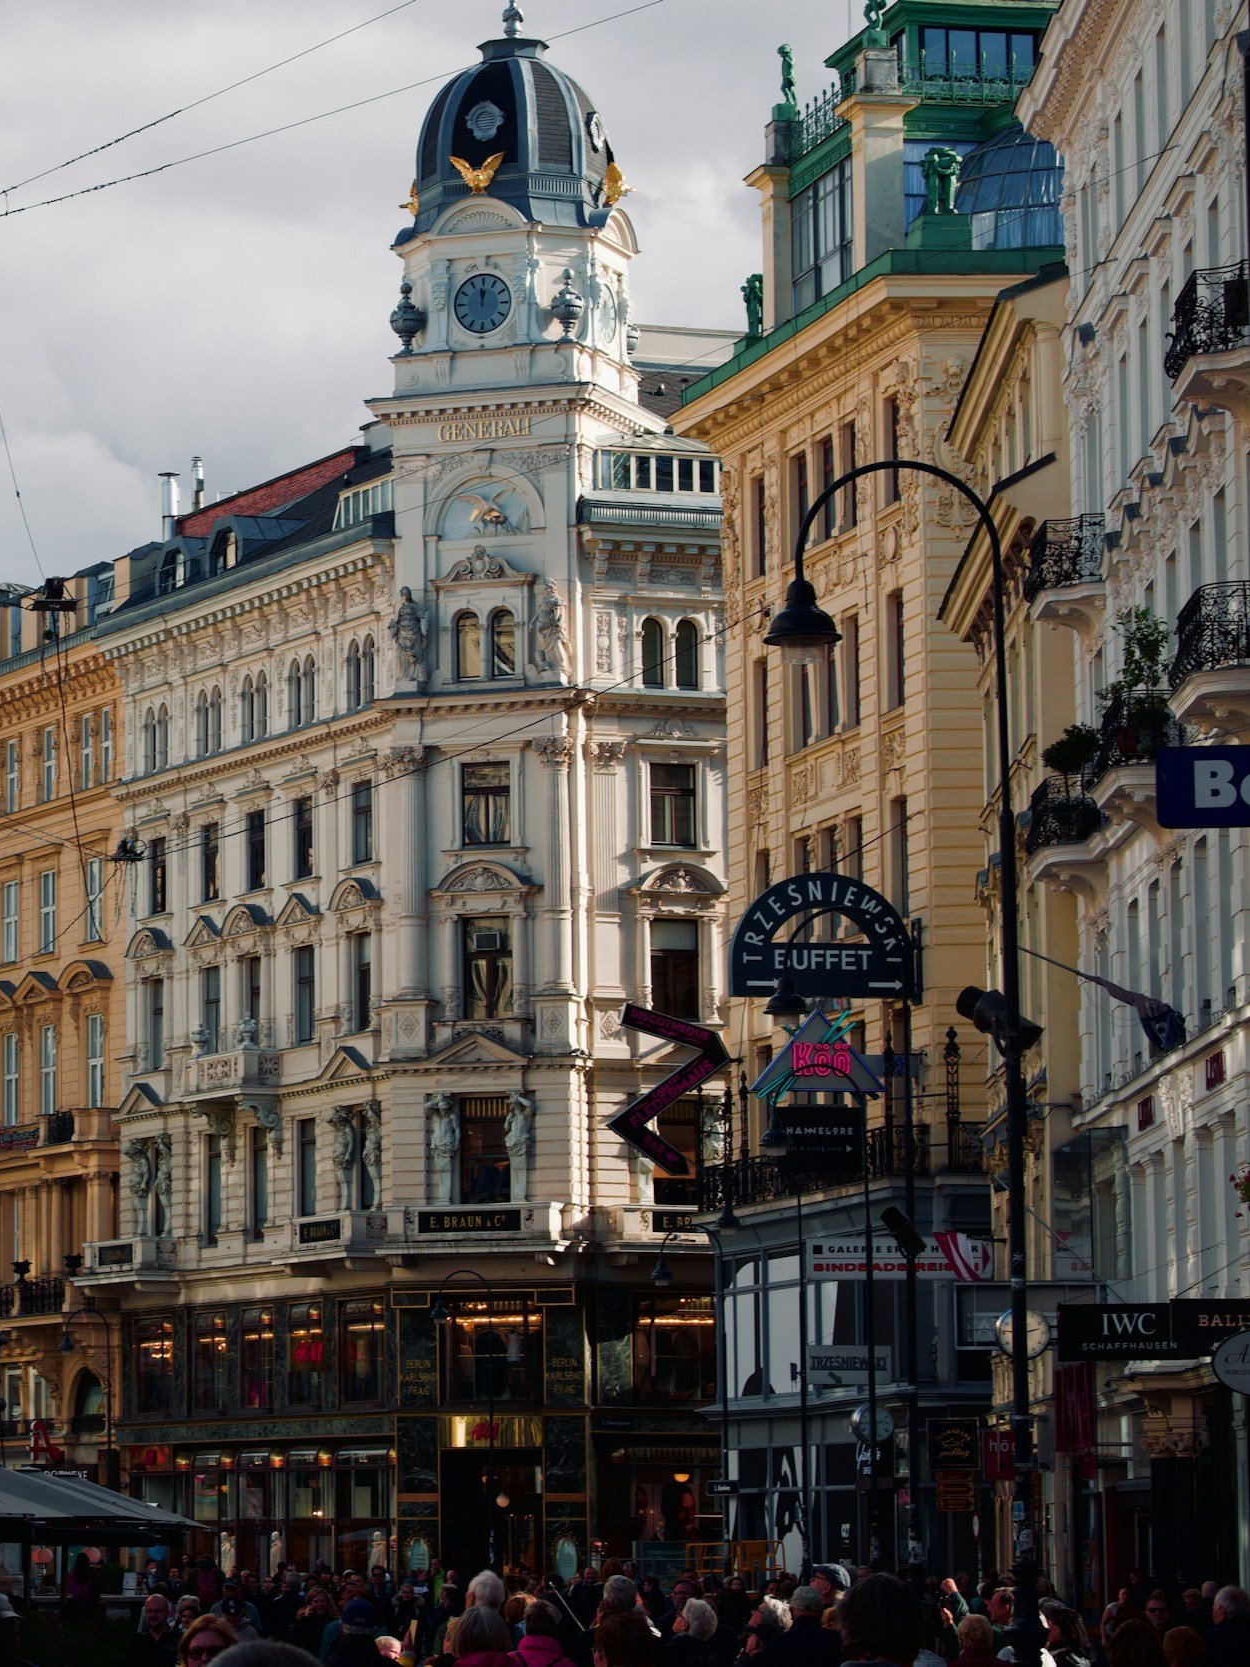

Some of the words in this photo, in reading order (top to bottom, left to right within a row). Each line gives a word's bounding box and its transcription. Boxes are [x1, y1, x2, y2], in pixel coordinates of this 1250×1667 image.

[437, 416, 531, 442] GENERALI
[1193, 760, 1250, 808] B
[774, 950, 873, 970] BUFFET
[630, 1009, 711, 1041] DISCOTHEQUE
[628, 1058, 715, 1128] FLEDERMAUS
[444, 1215, 482, 1228] BRAUN
[828, 1245, 881, 1253] GALERE
[1102, 1312, 1157, 1336] IWC
[1197, 1314, 1250, 1327] BALL
[1082, 1342, 1178, 1351] SCHAFFHAUSEN
[406, 1359, 431, 1369] BERLIN
[551, 1357, 578, 1367] BERLIN
[810, 1354, 887, 1370] TRZEŚNIEWKI
[408, 1386, 431, 1396] PRAG
[553, 1384, 576, 1394] PRAG
